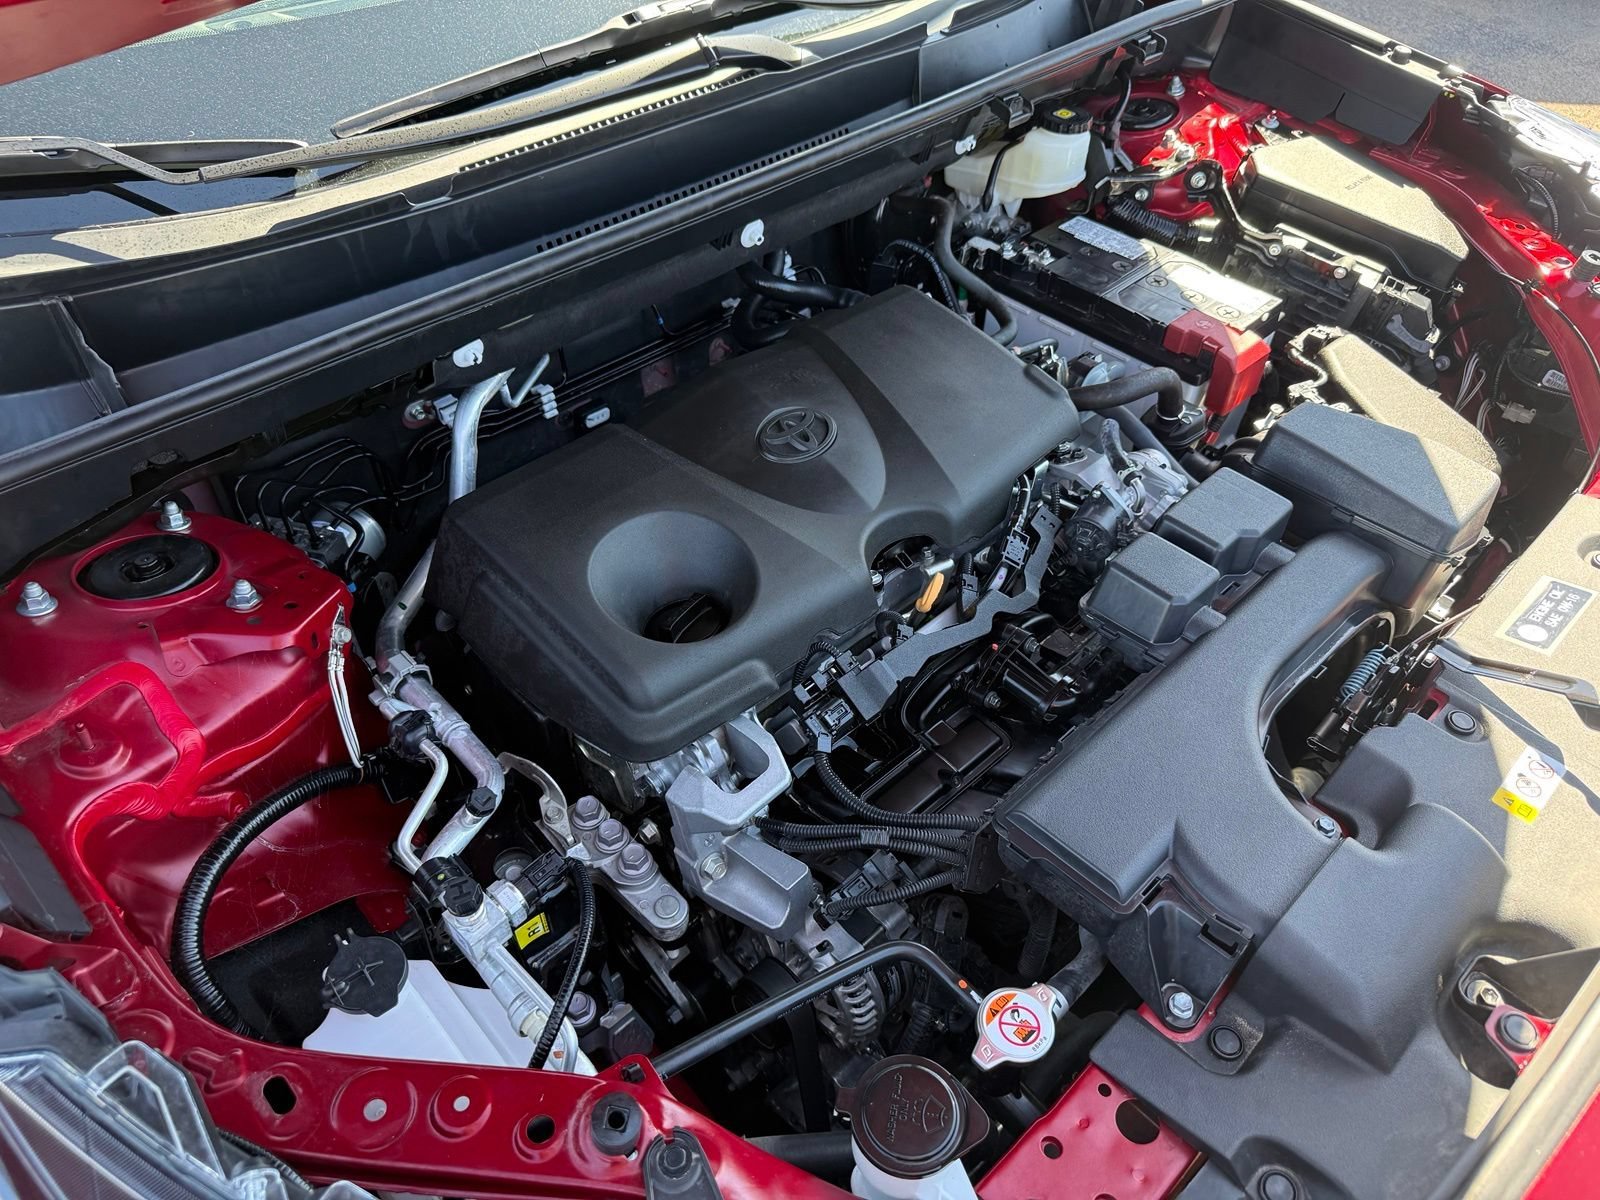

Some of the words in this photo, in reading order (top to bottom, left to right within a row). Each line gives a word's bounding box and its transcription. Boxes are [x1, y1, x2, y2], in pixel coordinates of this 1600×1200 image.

[1544, 613, 1565, 628] SAE
[899, 1097, 910, 1120] ONLY
[887, 1104, 899, 1142] WASHER
